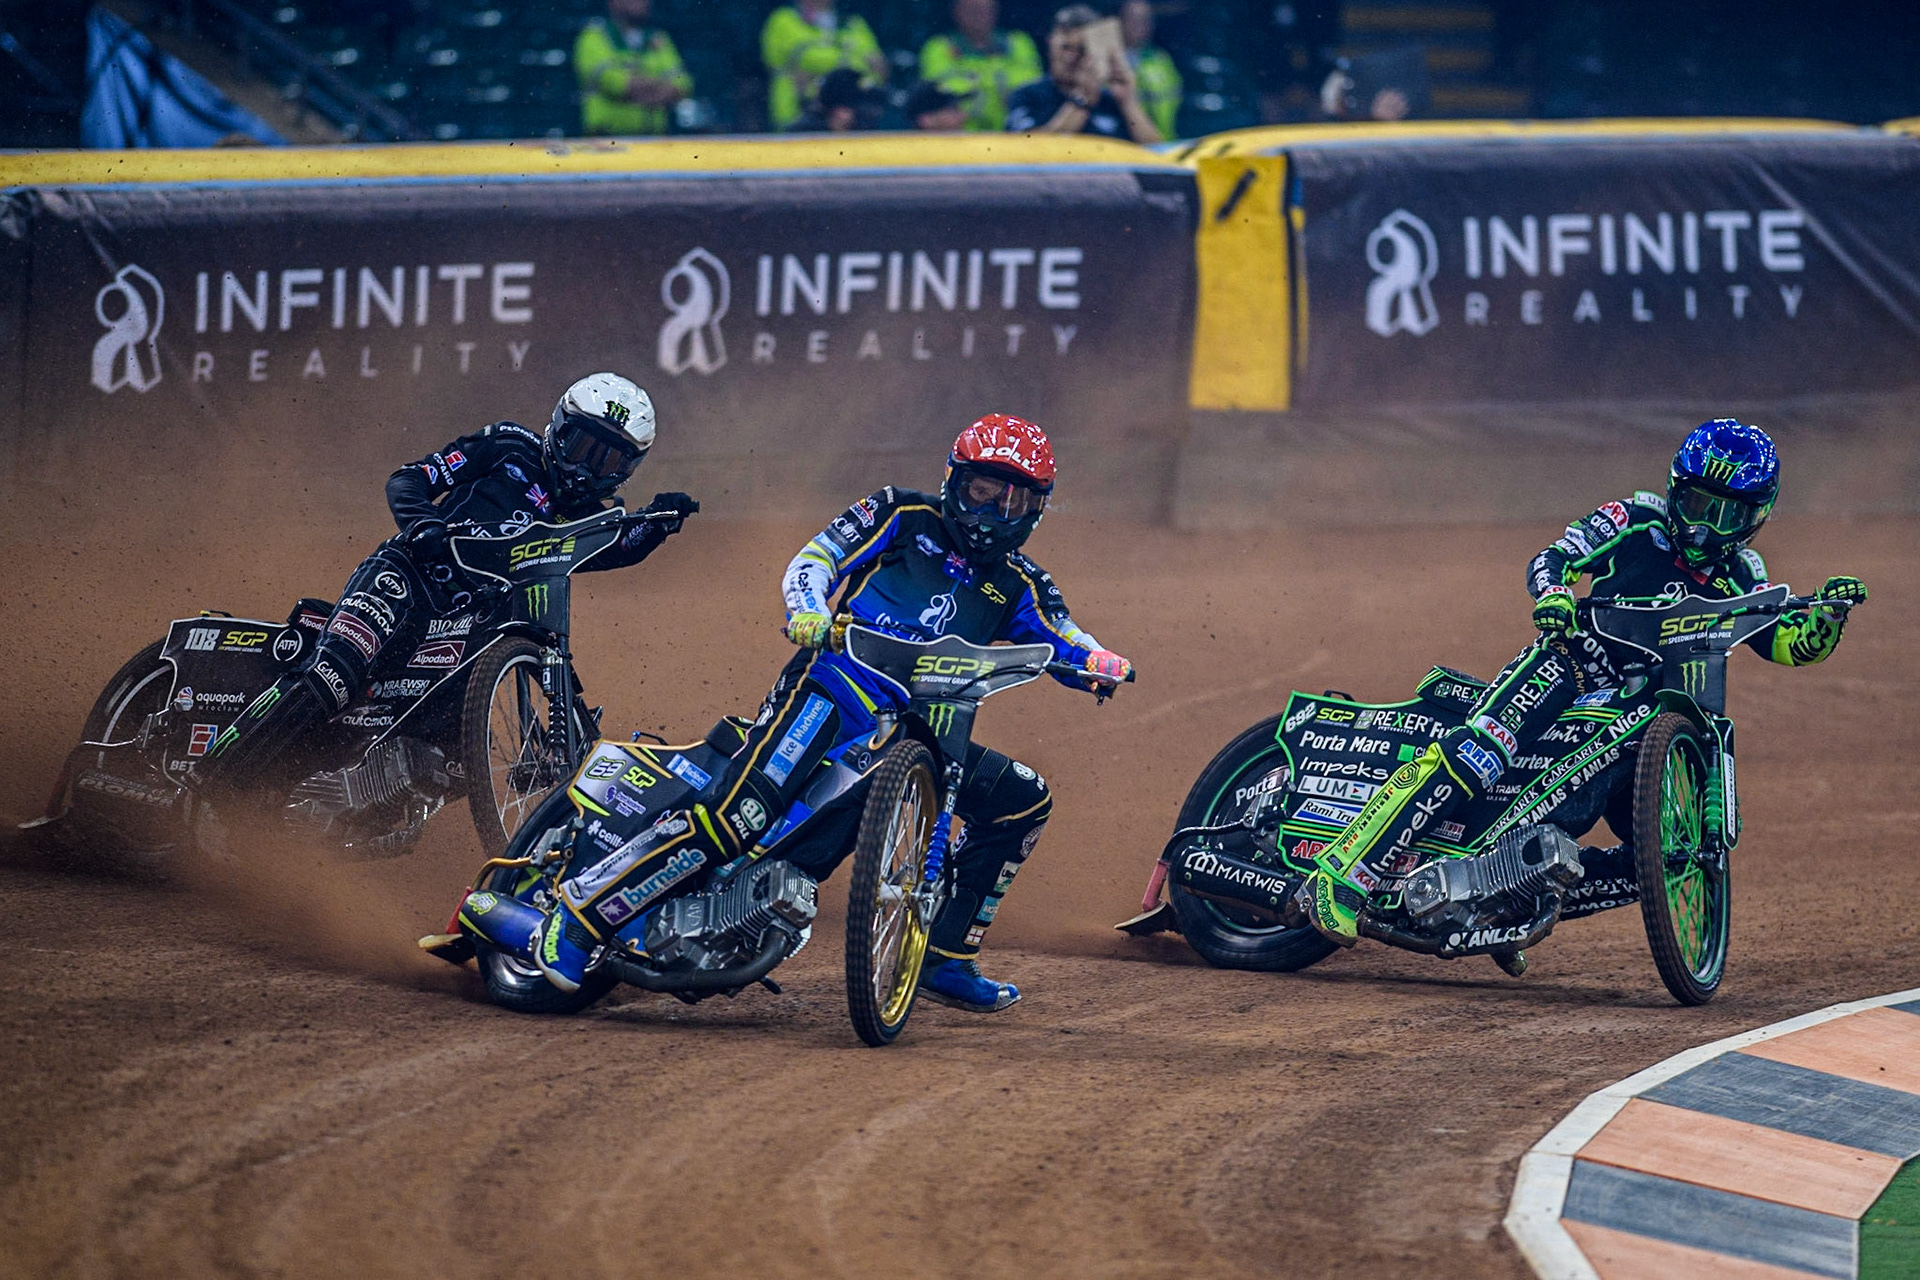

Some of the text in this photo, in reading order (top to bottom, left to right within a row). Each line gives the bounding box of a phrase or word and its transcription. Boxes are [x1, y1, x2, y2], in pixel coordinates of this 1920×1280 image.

[1464, 210, 1805, 279] INFINITE
[195, 262, 536, 333] INFINITE
[756, 247, 1083, 317] INFINITE
[1465, 285, 1802, 326] REALITY
[753, 325, 1078, 365] REALITY
[193, 340, 531, 383] REALITY
[980, 446, 1031, 471] BOLL
[516, 559, 540, 571] SPEEDWAY
[540, 556, 558, 564] GRAND
[559, 554, 572, 562] PRIX
[380, 574, 403, 595] ATPI
[341, 597, 394, 636] automax
[428, 619, 453, 634] BIO
[184, 627, 221, 651] 108
[222, 630, 268, 647] SGP
[276, 639, 299, 651] ATPI
[333, 621, 374, 655] Alpodach
[1668, 634, 1697, 645] SPEEDWAY
[1697, 632, 1718, 640] GRAND
[1718, 631, 1733, 639] PRIX
[412, 653, 455, 665] Alpodach
[913, 655, 981, 676] SGP
[920, 675, 952, 683] SPEEDWAY
[1511, 658, 1565, 713] REXER
[196, 691, 246, 706] aquapark
[1317, 707, 1355, 721] SGP
[781, 741, 798, 758] Ice
[791, 699, 826, 741] Machines
[1285, 701, 1317, 733] 692
[1373, 711, 1429, 733] REXER
[1607, 703, 1651, 740] Nice
[1299, 730, 1391, 756] Porta Mare
[622, 765, 657, 788] SGP
[1299, 756, 1389, 781] Impeks
[1542, 736, 1605, 788] GARCAREK
[1582, 747, 1621, 782] ANLAS
[1235, 774, 1278, 807] Porta
[1530, 788, 1568, 823] ANLAS
[1304, 800, 1335, 818] Rami
[1486, 785, 1540, 840] GARCAREK
[730, 812, 751, 840] BOLL
[1371, 784, 1453, 873] Impeks
[622, 849, 703, 906] burnside
[1216, 862, 1287, 897] MARWIS
[1318, 877, 1340, 930] daytona
[1469, 923, 1533, 948] ANLAS
